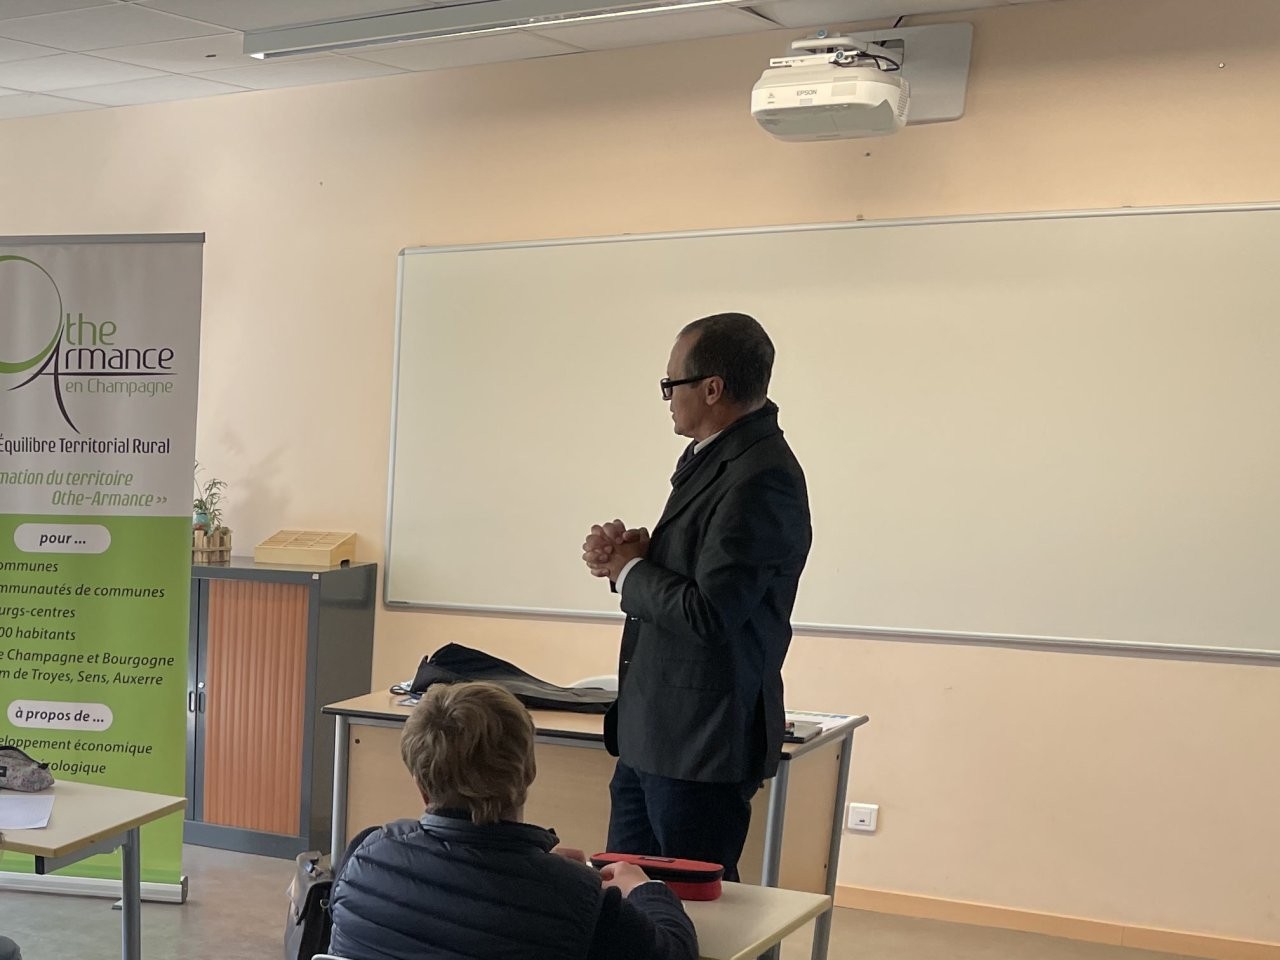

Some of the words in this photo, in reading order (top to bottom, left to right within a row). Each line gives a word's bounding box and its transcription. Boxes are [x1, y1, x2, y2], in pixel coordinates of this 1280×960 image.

[796, 89, 818, 97] EPSON
[65, 381, 83, 393] en
[87, 378, 174, 397] Champagne
[59, 437, 129, 453] Territorial
[132, 437, 170, 454] Rural
[46, 470, 63, 486] du
[66, 470, 134, 487] territoire
[52, 490, 154, 507] Othe-Armance
[39, 534, 72, 546] pour
[75, 583, 91, 596] de
[94, 586, 165, 598] communes
[15, 626, 76, 641] habitants
[7, 648, 84, 666] Champagne
[86, 653, 100, 664] et
[102, 652, 175, 669] Bourgogne
[13, 667, 29, 680] de
[31, 668, 74, 684] Troyes,
[77, 670, 110, 685] Sens,
[112, 672, 163, 686] Auxerre
[15, 706, 24, 719] à
[25, 710, 71, 723] propos
[74, 709, 91, 722] de
[74, 739, 153, 757] économique
